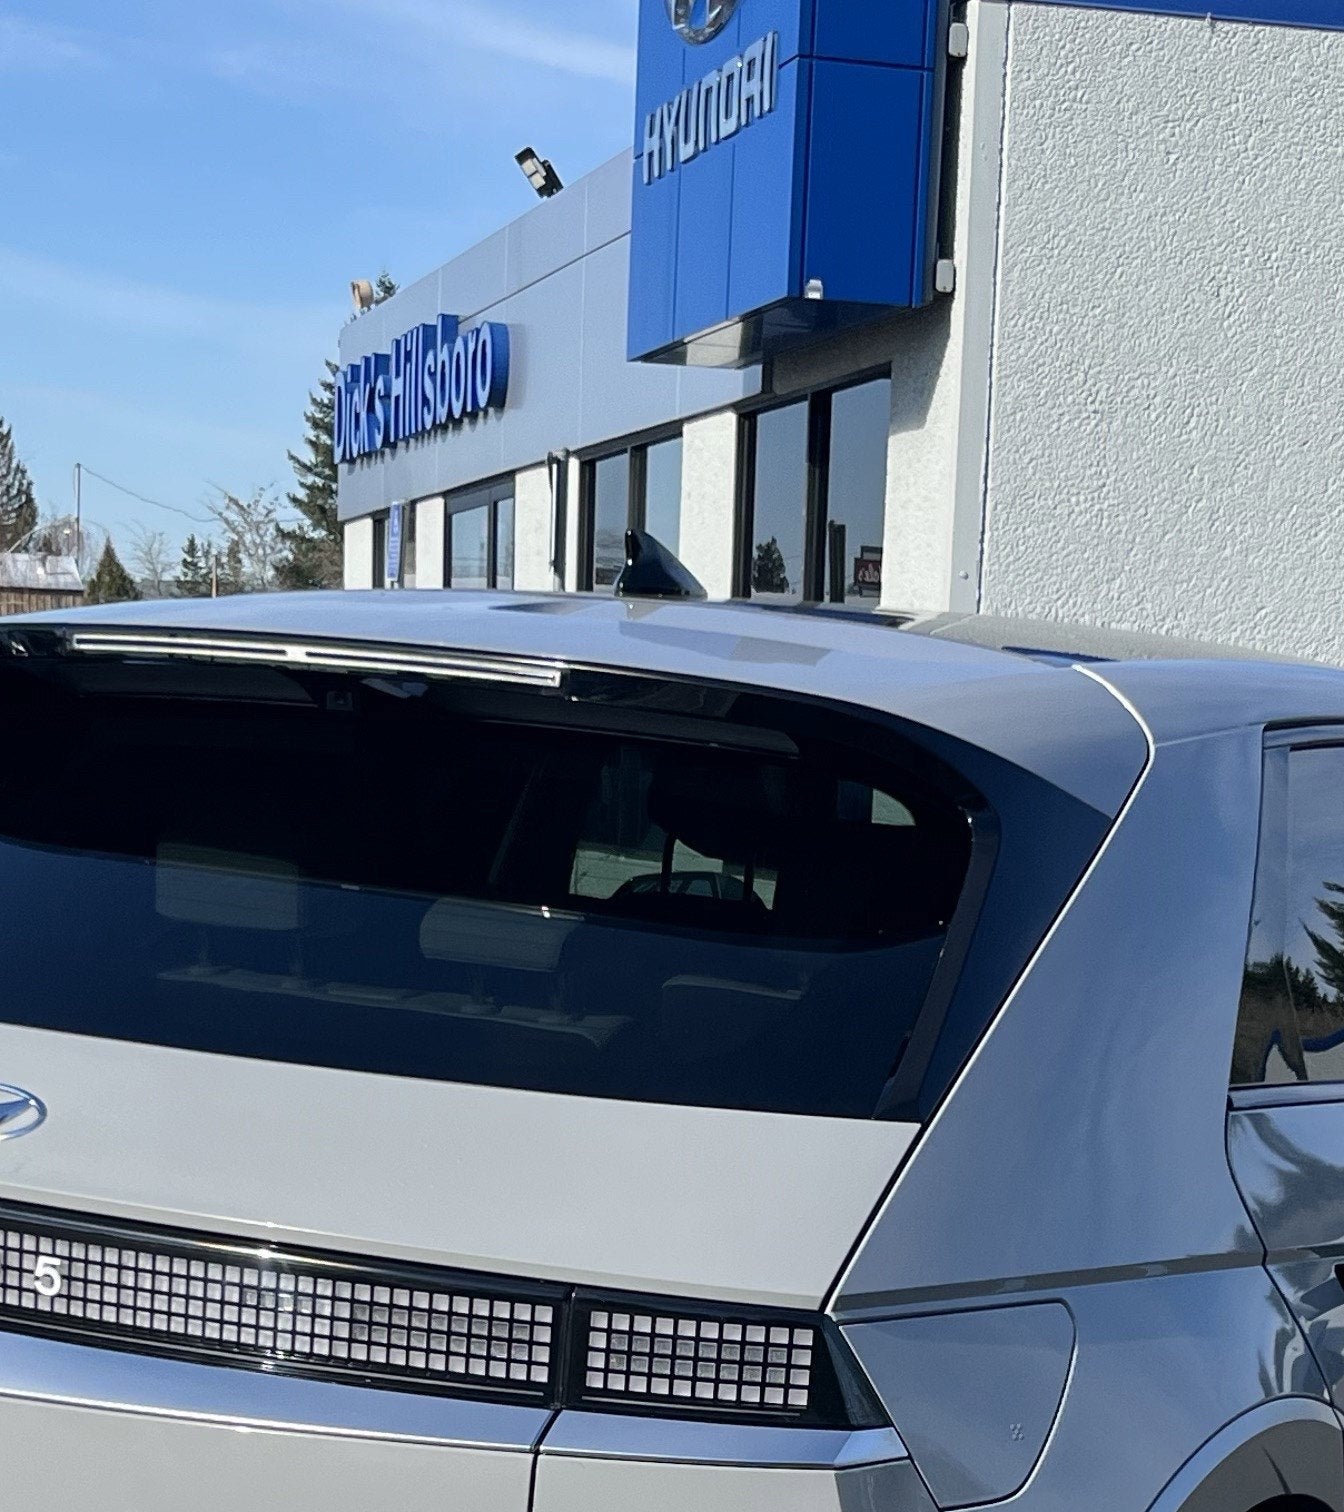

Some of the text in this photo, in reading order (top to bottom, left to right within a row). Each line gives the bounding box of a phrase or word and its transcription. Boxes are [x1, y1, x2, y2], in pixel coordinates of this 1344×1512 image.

[643, 30, 778, 185] HYUNDAI
[333, 314, 502, 465] Dick's Hillsboro
[33, 1255, 62, 1297] 5
